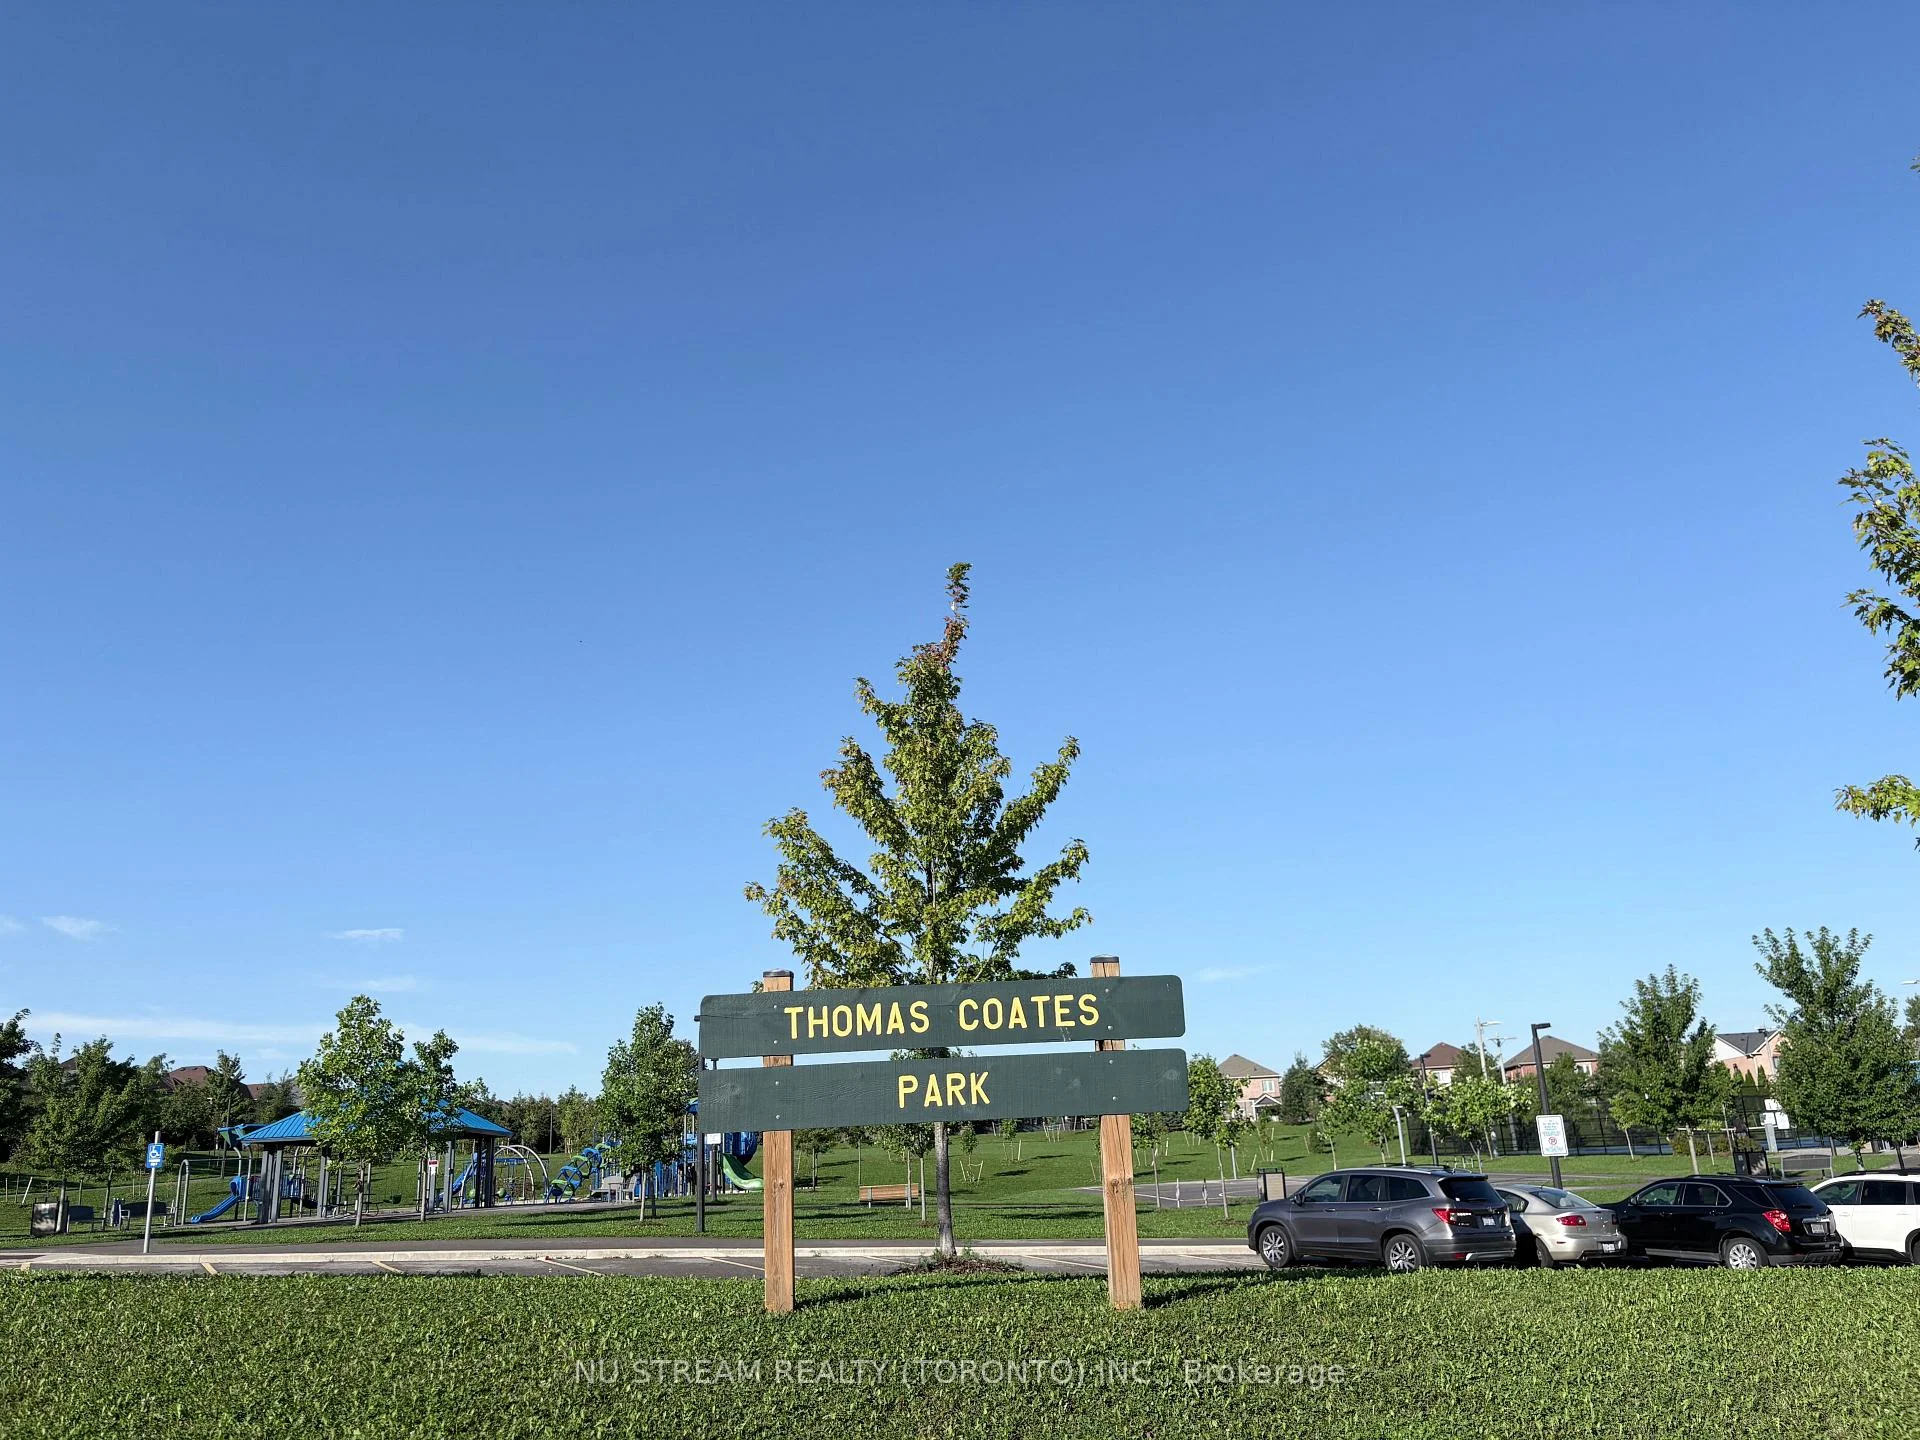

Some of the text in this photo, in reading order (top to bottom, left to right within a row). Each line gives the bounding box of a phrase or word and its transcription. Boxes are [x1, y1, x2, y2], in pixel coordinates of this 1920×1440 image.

[784, 993, 1100, 1040] THOMAS COATES
[898, 1071, 990, 1109] PARK
